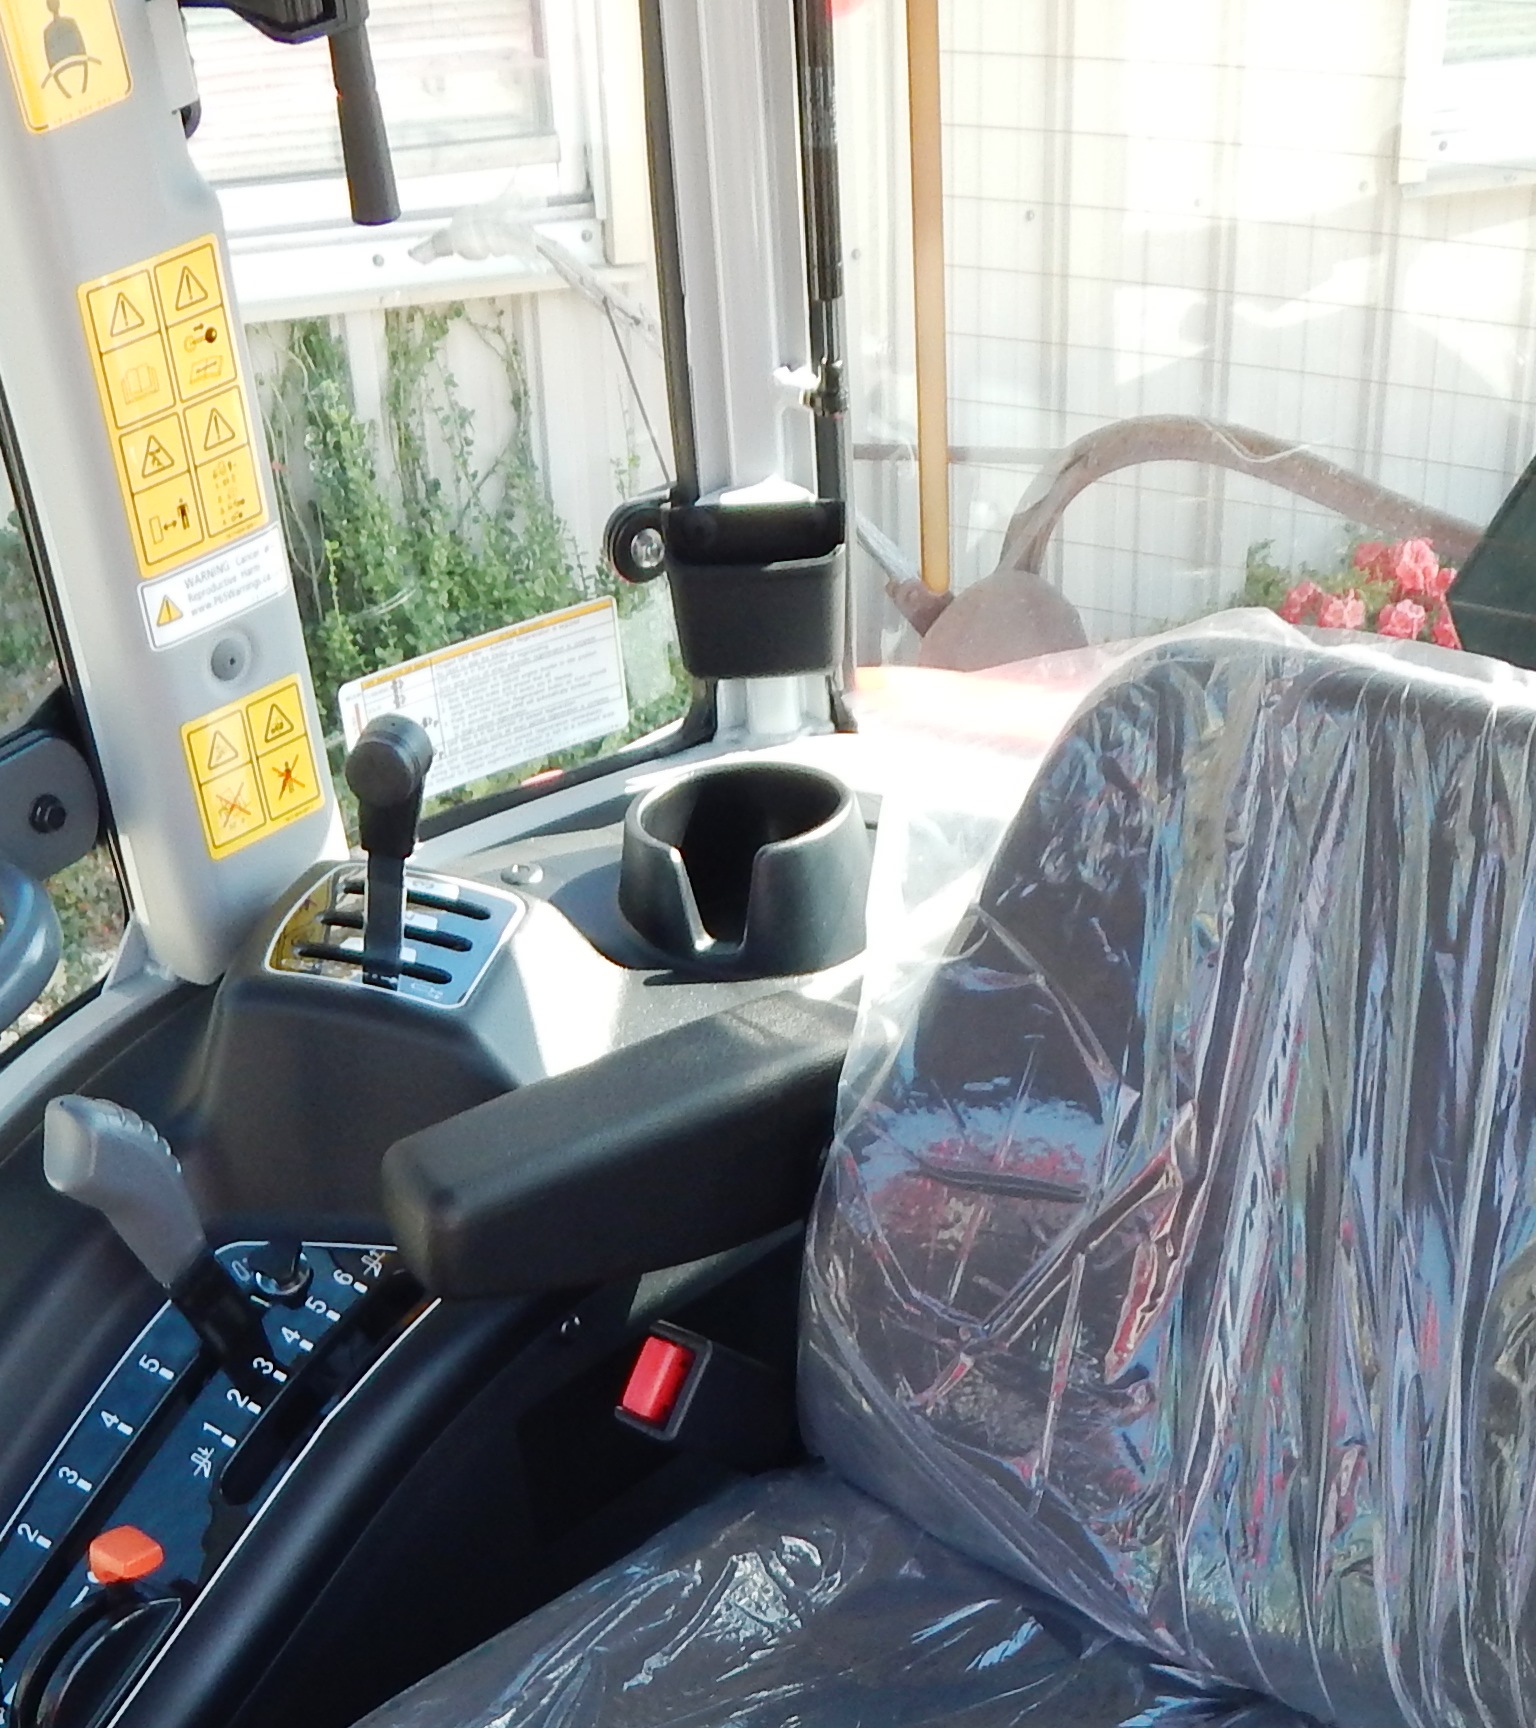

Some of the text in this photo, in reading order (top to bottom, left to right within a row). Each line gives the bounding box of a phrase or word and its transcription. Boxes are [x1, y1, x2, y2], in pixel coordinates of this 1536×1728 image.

[186, 574, 237, 602] Reproductive
[234, 548, 259, 566] Cancer
[203, 1269, 353, 1435] 1 2 3 4 5 6
[17, 1523, 39, 1542] 2
[59, 1466, 79, 1484] 3
[101, 1410, 119, 1428] 4
[139, 1354, 160, 1372] 5
